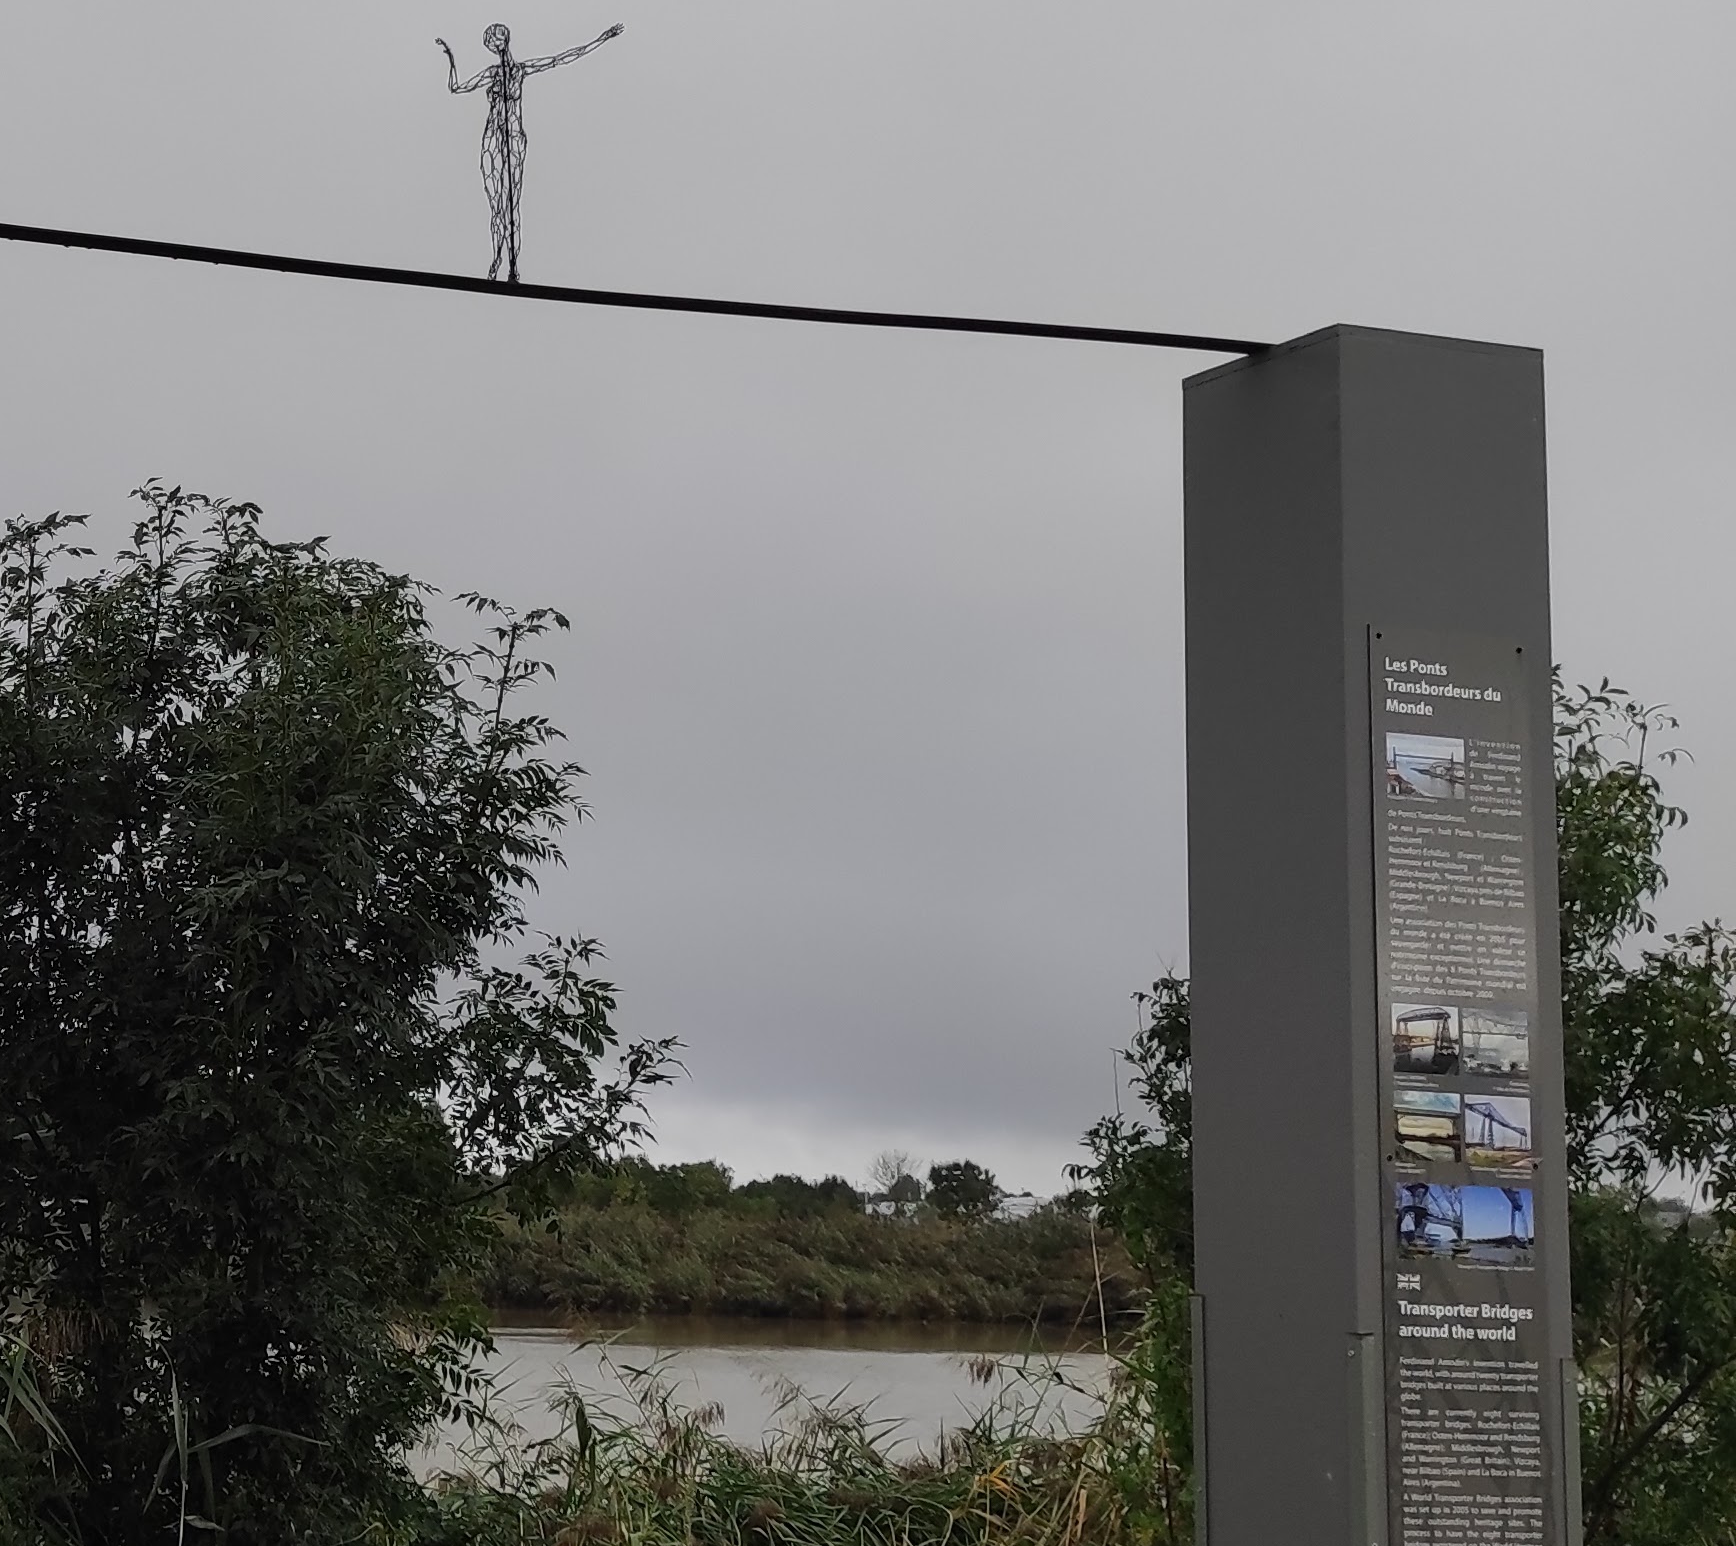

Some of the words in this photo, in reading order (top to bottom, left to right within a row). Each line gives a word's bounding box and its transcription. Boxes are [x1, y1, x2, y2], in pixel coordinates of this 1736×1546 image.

[1385, 656, 1408, 672] Les
[1410, 660, 1448, 676] Ponts
[1384, 678, 1482, 700] Transbordeurs
[1484, 687, 1502, 702] du
[1386, 698, 1434, 716] Monde
[1398, 1300, 1480, 1320] Transporter
[1480, 1303, 1534, 1323] Bridges
[1398, 1324, 1450, 1338] around
[1451, 1324, 1476, 1340] the
[1476, 1326, 1516, 1342] world
